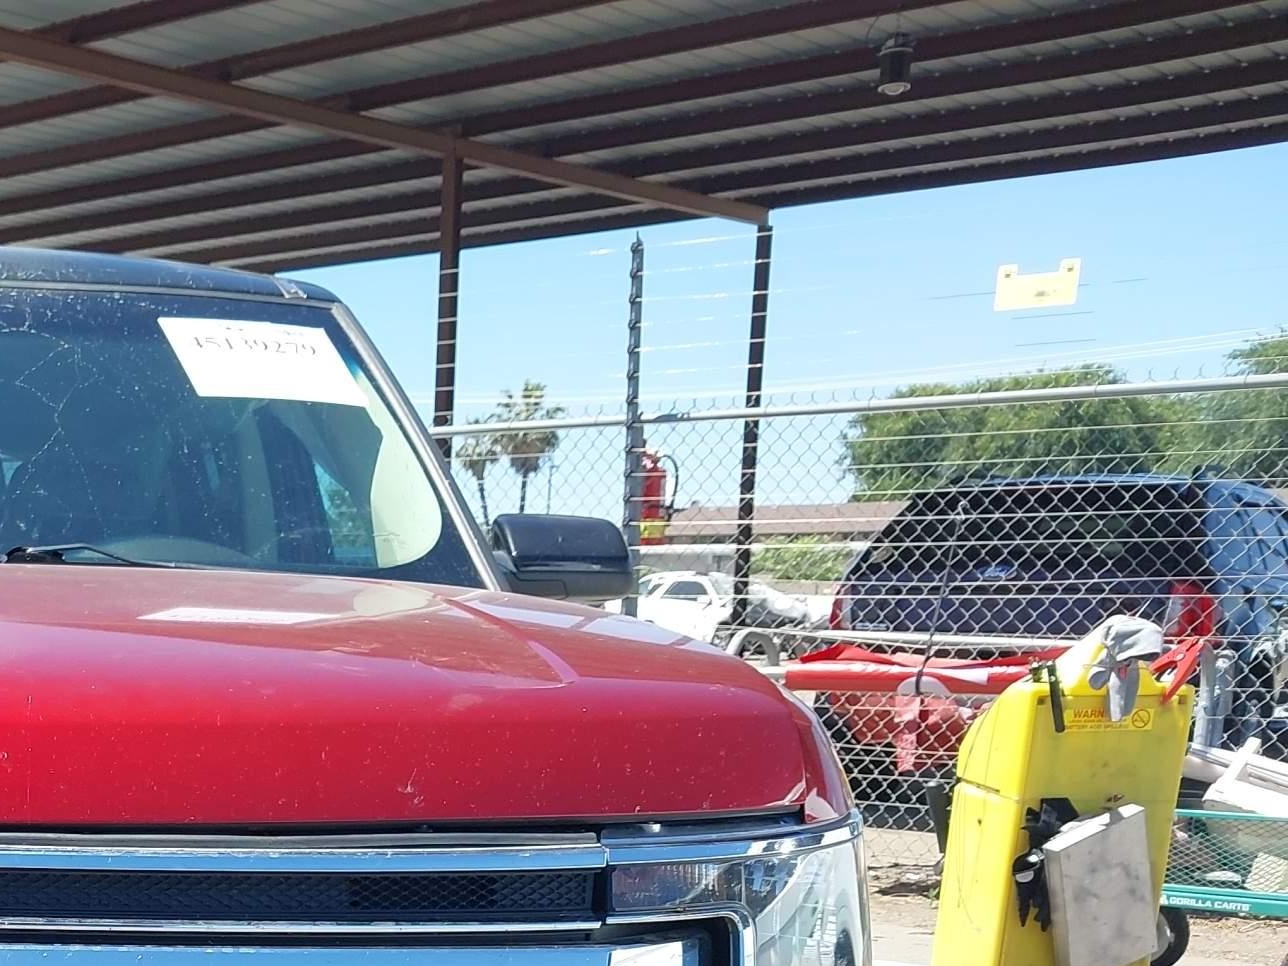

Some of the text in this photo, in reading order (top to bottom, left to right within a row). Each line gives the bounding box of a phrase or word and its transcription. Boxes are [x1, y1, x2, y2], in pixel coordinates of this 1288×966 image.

[1073, 709, 1105, 719] WARN
[1169, 896, 1250, 912] GORILLA CARTS
